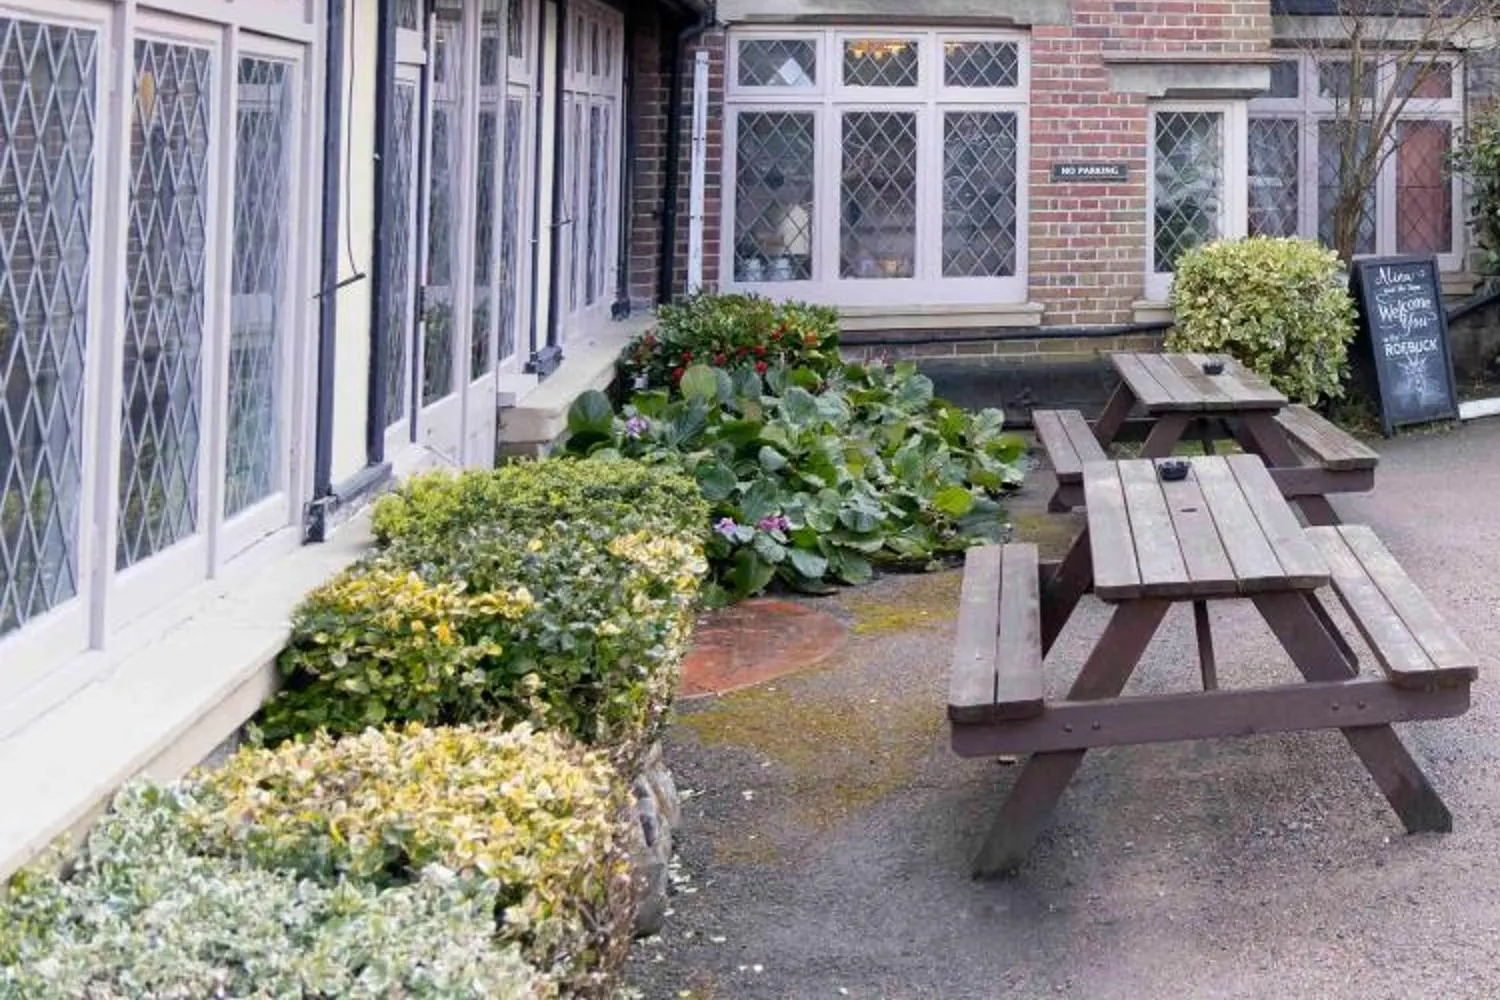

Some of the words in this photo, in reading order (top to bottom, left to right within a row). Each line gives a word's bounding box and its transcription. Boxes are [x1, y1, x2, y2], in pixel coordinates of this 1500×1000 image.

[1061, 167, 1077, 175] NO
[1077, 166, 1119, 175] PARKING
[1378, 297, 1432, 322] Welcome
[1384, 338, 1438, 357] ROEBUCK
